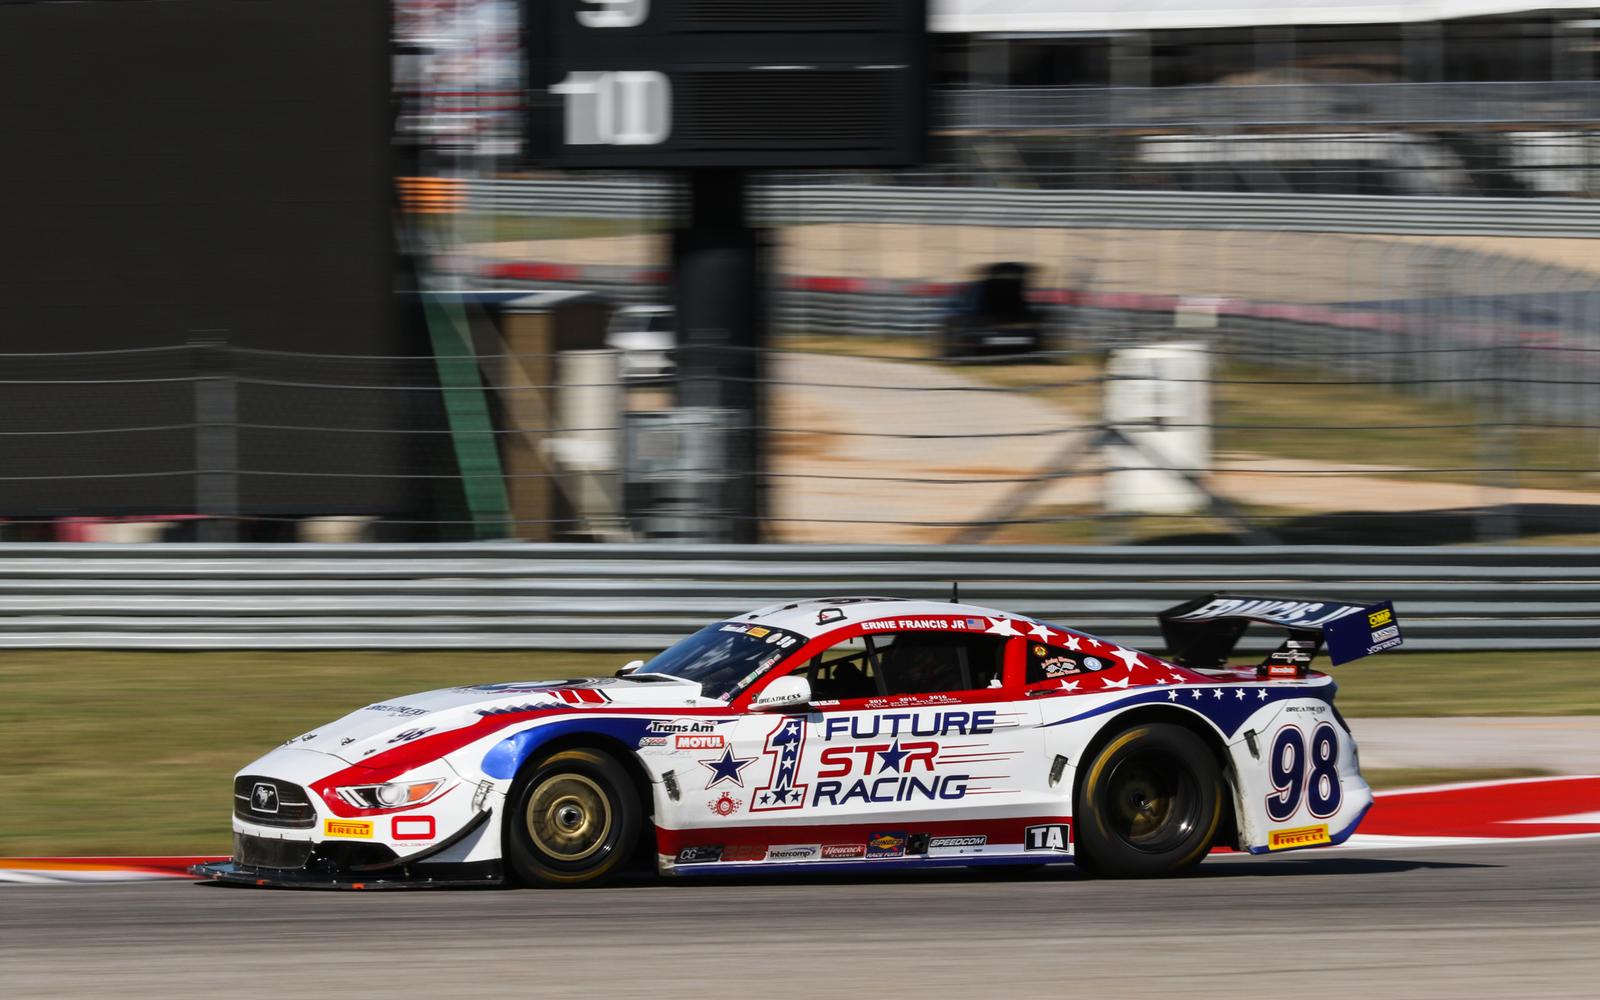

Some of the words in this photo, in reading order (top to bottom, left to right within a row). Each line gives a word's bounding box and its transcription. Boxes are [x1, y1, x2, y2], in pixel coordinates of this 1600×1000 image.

[548, 70, 674, 145] 10
[861, 620, 897, 631] ERNIE
[899, 620, 948, 630] FRANCIS
[951, 620, 966, 630] JR
[652, 722, 688, 732] Trans
[690, 722, 714, 732] Am
[825, 710, 996, 741] FUTURE
[677, 736, 723, 748] MOTUL
[1265, 721, 1343, 822] 98
[812, 775, 970, 807] RACING
[328, 822, 370, 835] PIRELLI
[930, 837, 985, 847] SPEEDCOM
[1031, 826, 1064, 849] TA
[1273, 828, 1324, 845] PIRELLI
[770, 848, 812, 859] Intercomp
